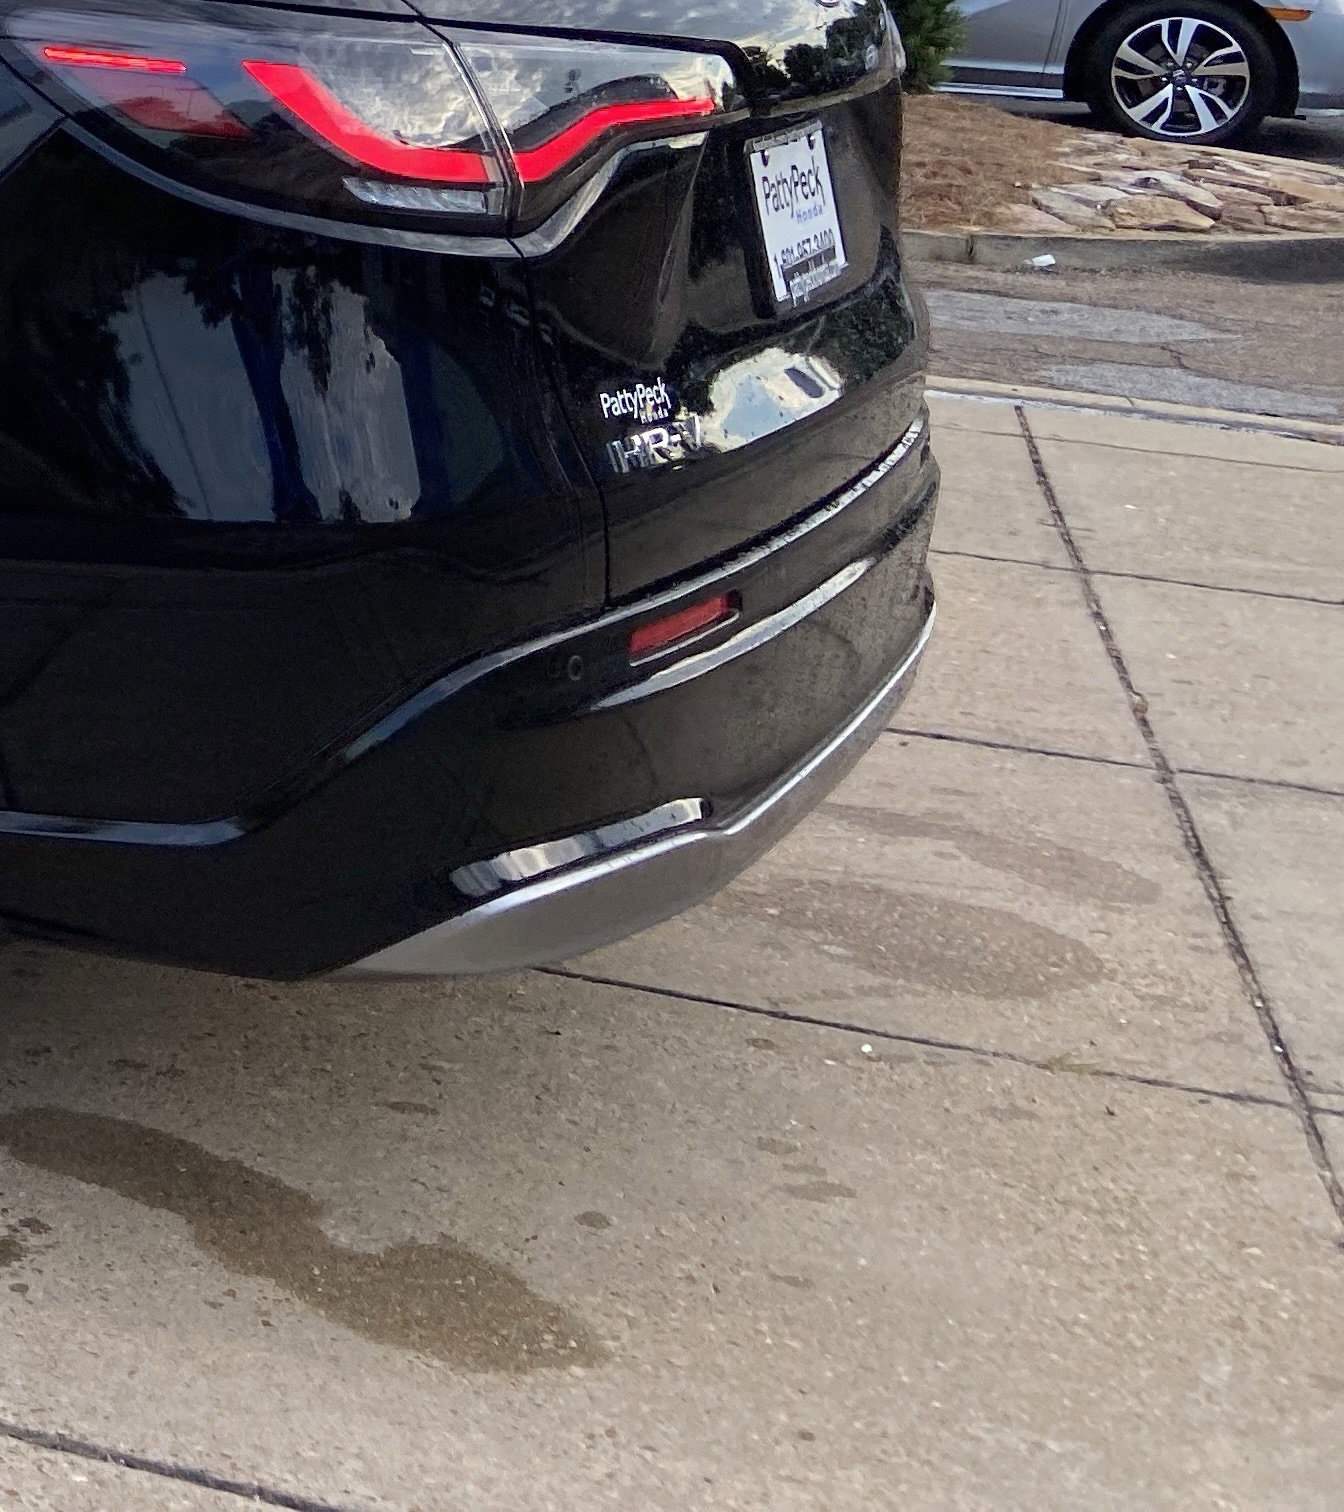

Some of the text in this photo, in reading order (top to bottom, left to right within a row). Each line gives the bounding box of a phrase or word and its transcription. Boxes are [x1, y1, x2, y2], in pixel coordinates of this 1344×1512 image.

[762, 155, 826, 219] PattyPeck
[795, 203, 823, 224] Honda
[599, 377, 672, 419] PattyPeck
